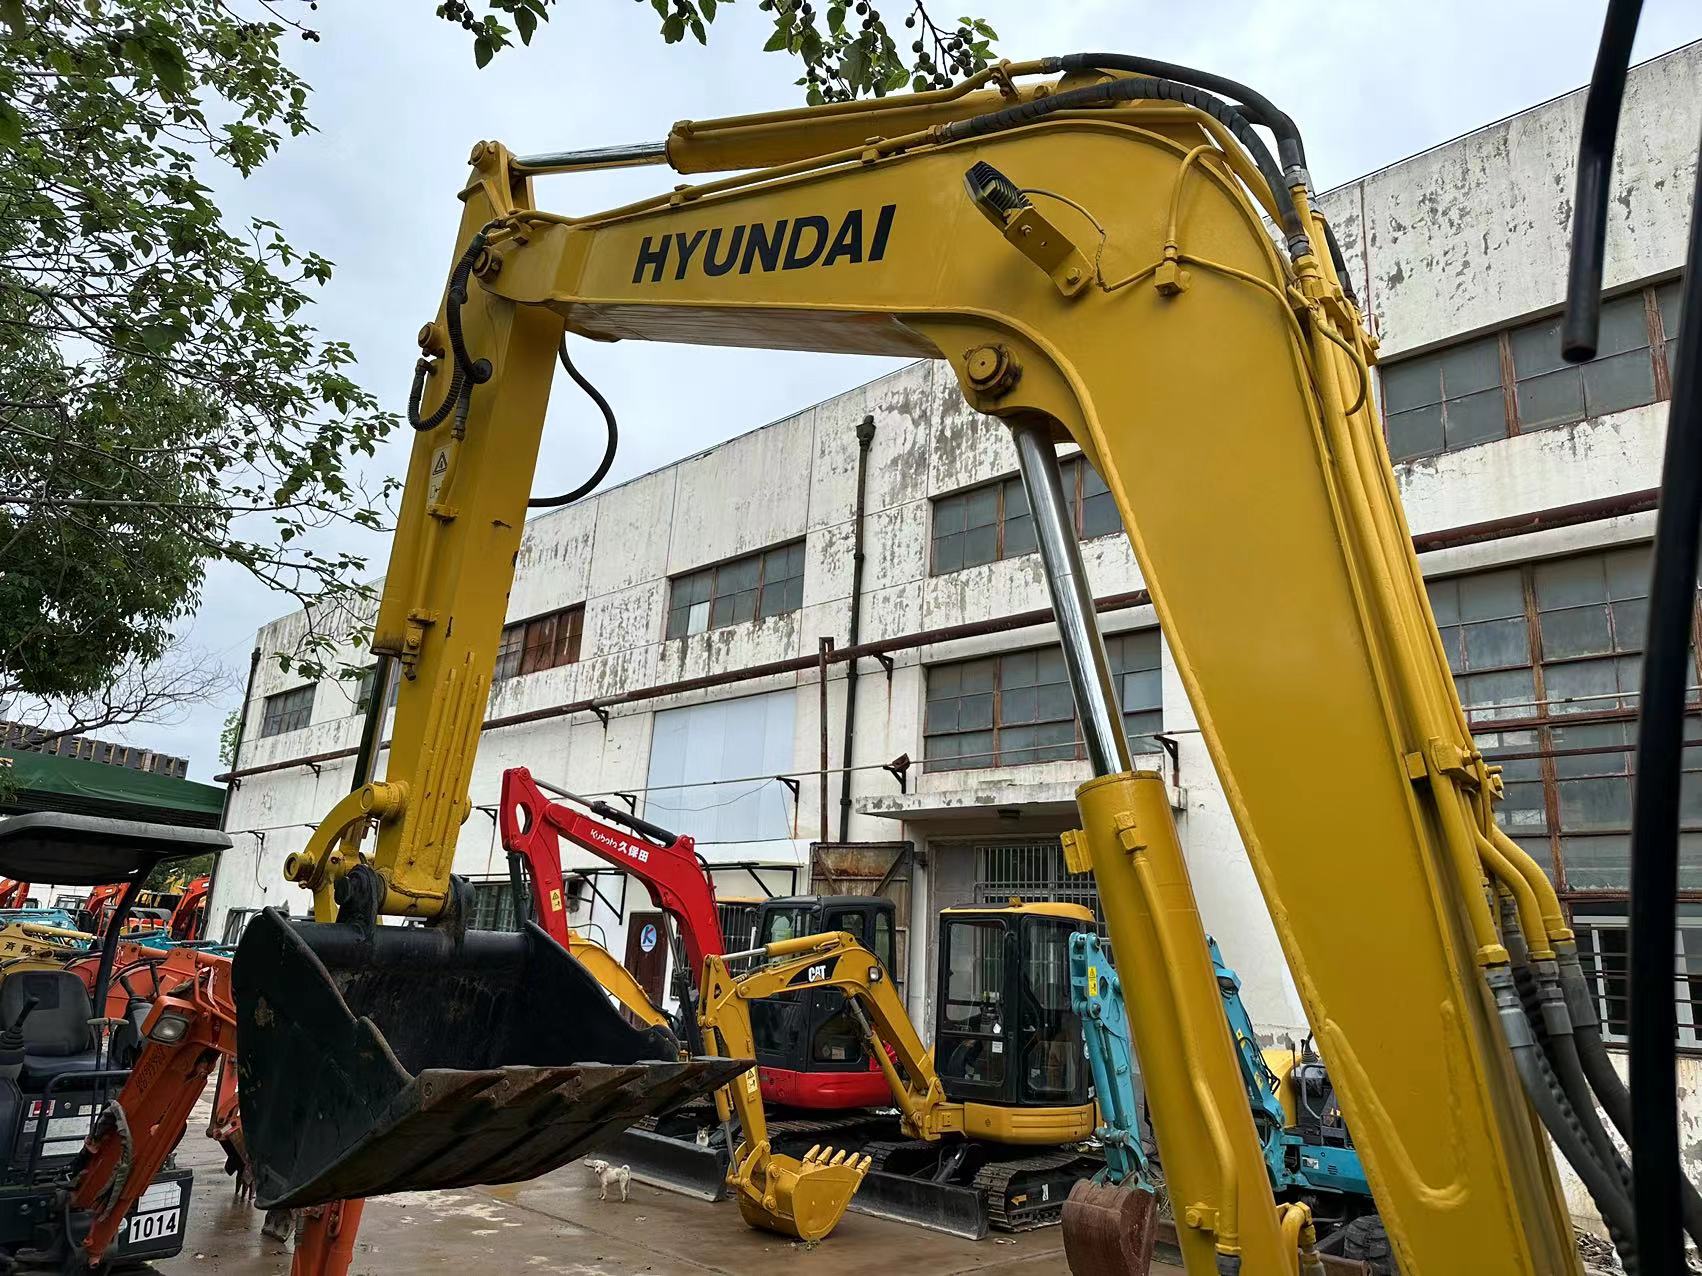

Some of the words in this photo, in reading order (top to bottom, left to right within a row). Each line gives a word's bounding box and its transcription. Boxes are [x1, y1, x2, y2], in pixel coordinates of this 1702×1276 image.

[632, 204, 897, 283] HYUNDAI
[591, 829, 618, 848] Kubota
[617, 841, 649, 862] 久保田
[808, 965, 826, 982] CAT
[133, 1213, 176, 1240] 1014
